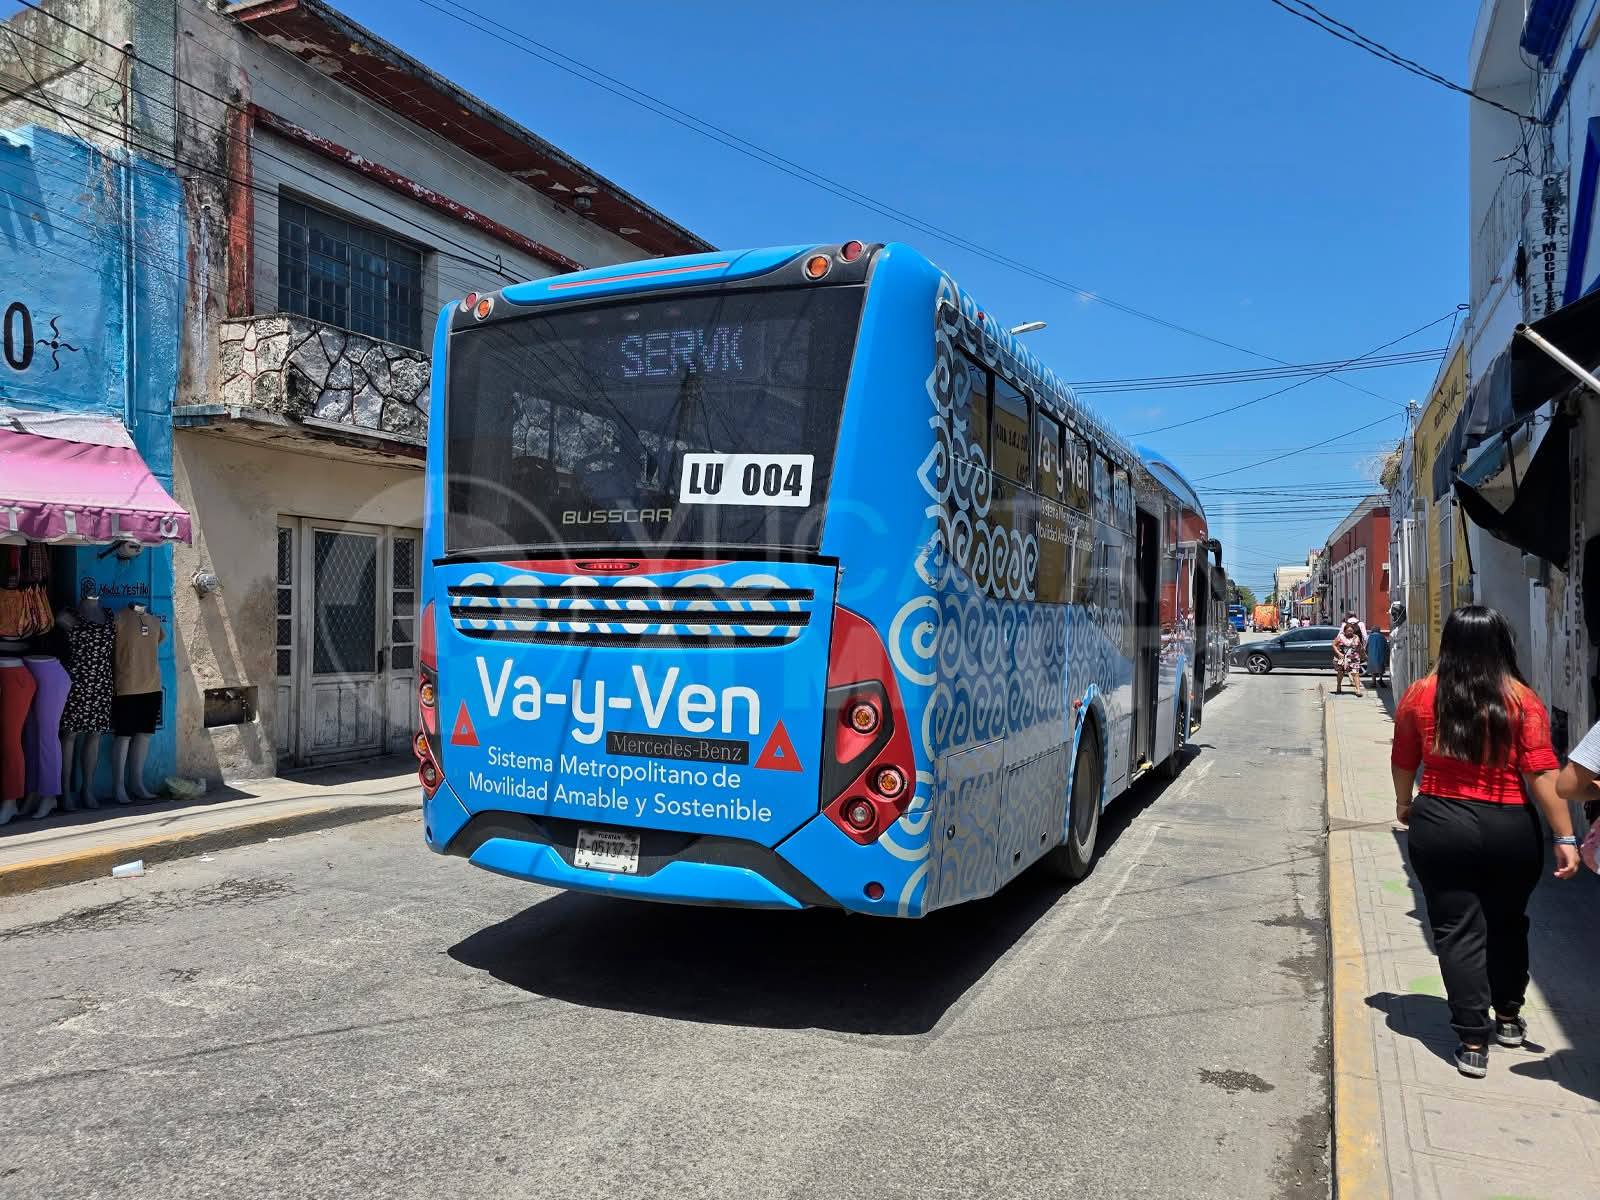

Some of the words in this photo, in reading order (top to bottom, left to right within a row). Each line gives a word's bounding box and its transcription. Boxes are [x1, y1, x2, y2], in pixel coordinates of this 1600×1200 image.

[688, 461, 722, 496] LU
[742, 462, 804, 498] 004
[562, 507, 673, 525] BUSSCAR
[475, 655, 761, 745] Va-y-Ven
[487, 746, 554, 774] Sistema
[559, 756, 710, 791] Metropolitano
[712, 765, 742, 789] de
[611, 734, 744, 763] Mercedes-Benz
[468, 769, 548, 802] Movilidad
[553, 788, 629, 811] Amable
[635, 796, 648, 818] y
[653, 792, 773, 824] Sostenible
